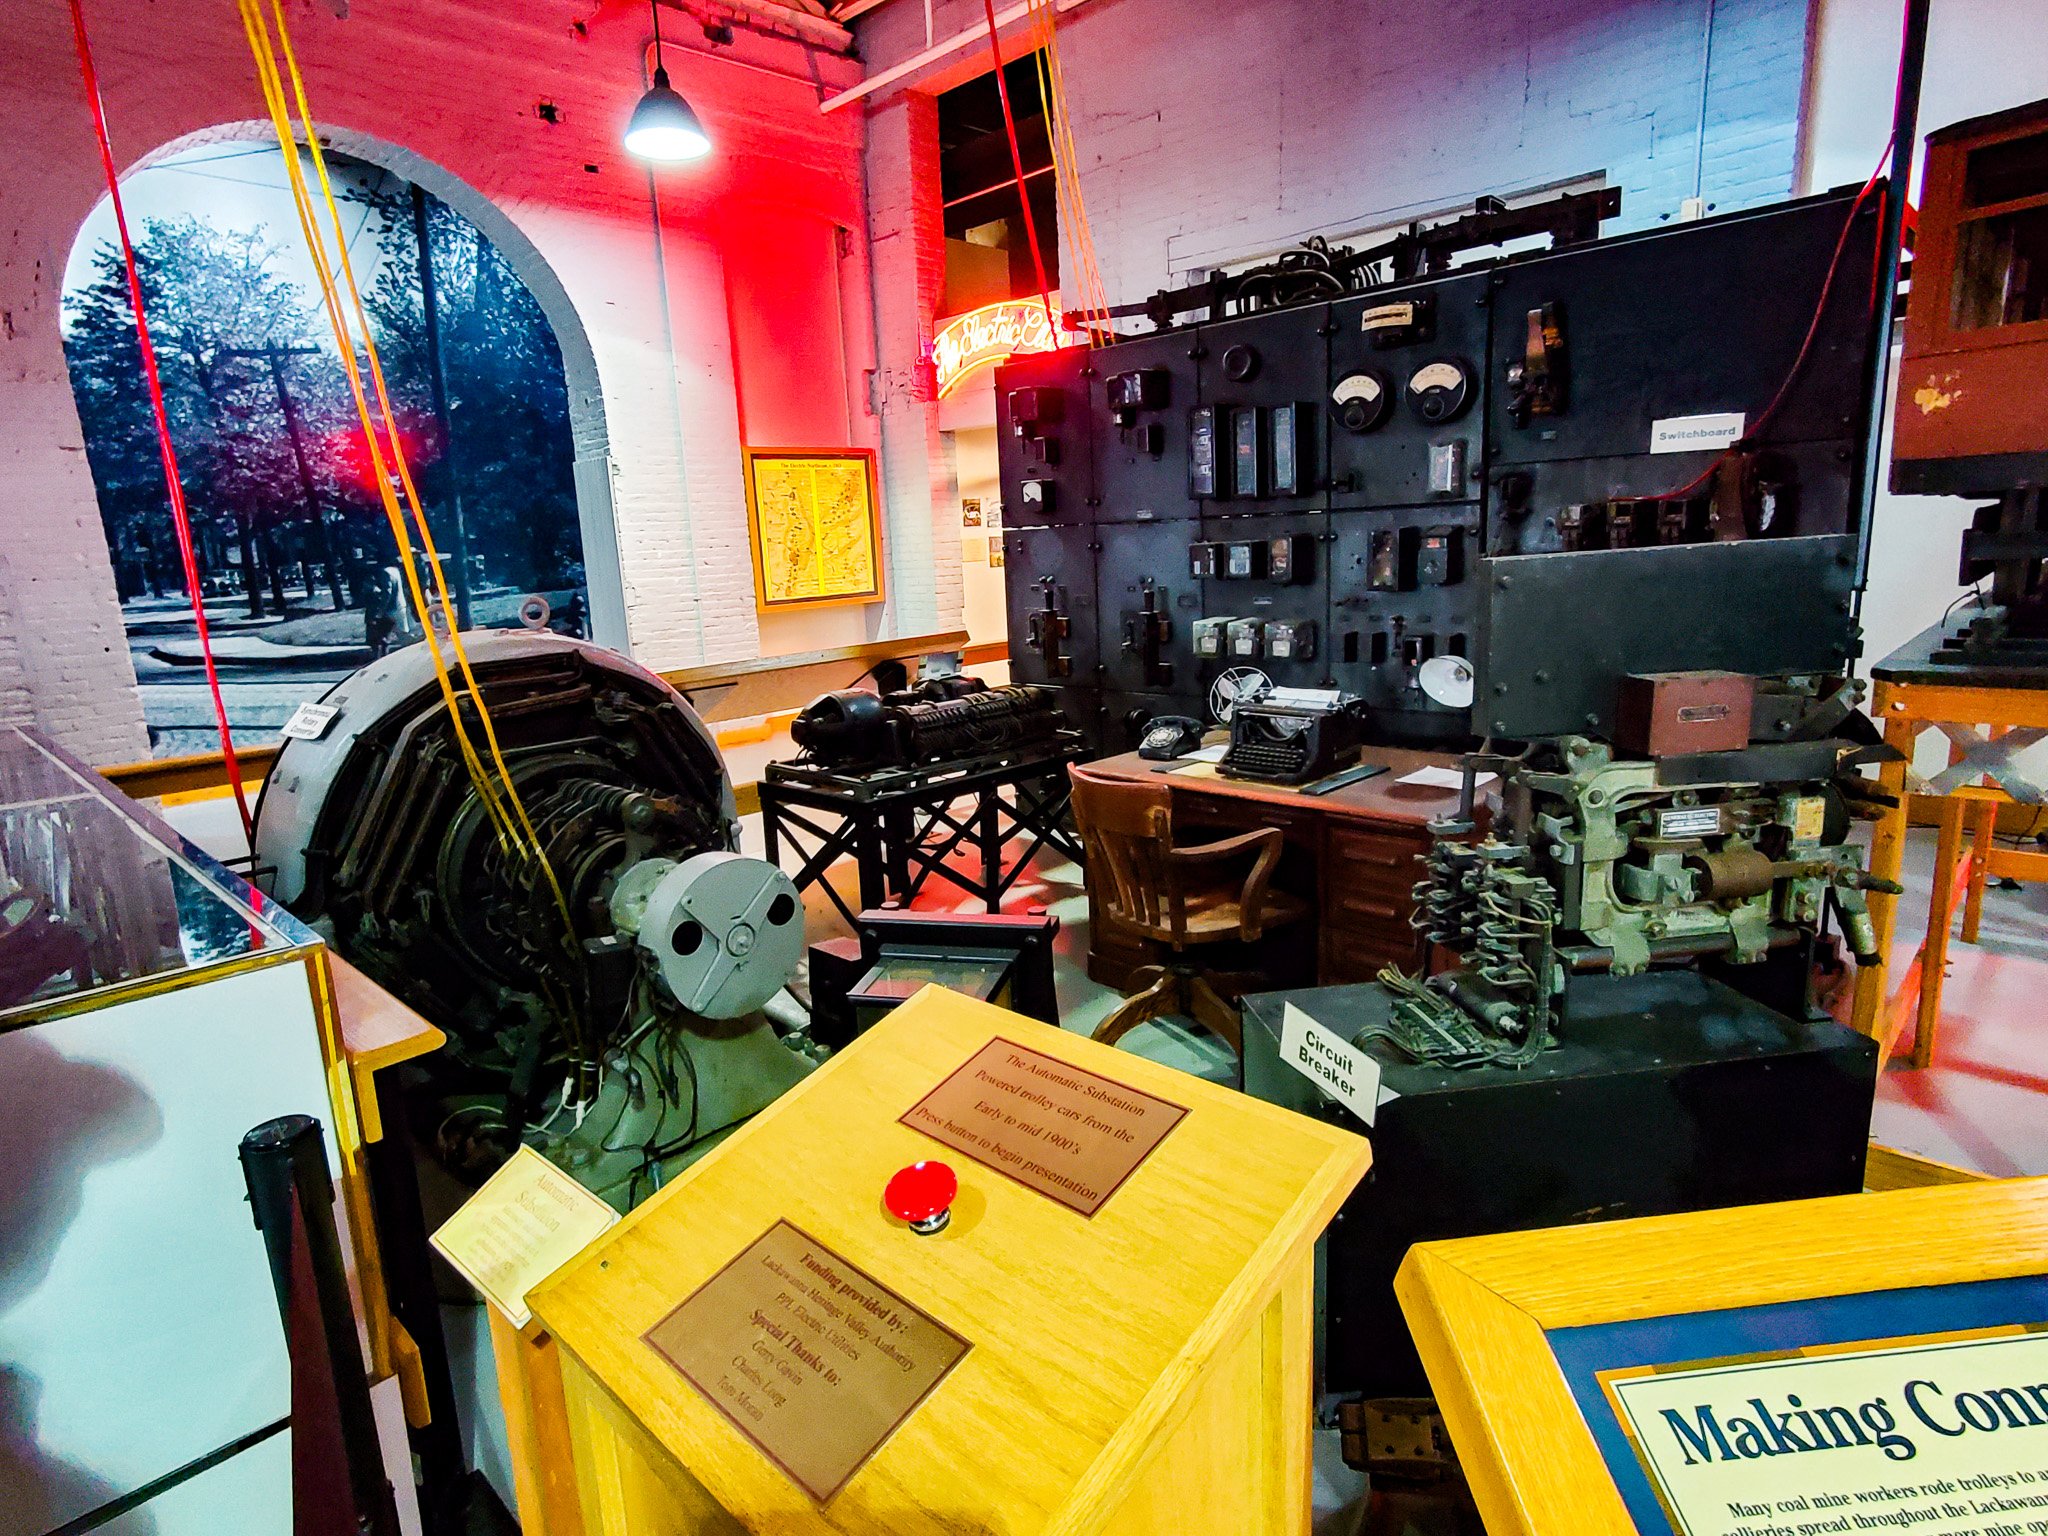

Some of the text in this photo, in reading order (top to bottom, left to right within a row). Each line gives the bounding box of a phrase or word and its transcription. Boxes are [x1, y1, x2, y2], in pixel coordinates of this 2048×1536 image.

[961, 306, 1021, 357] Electric
[1659, 427, 1736, 441] Switchboard
[1299, 1045, 1356, 1097] Breaker
[1305, 1030, 1353, 1075] Circuit
[975, 1069, 1134, 1143] Powered trolley cars from the
[1006, 1054, 1145, 1117] The Automatic Substation
[974, 1100, 1081, 1155] Early to mid 1900's
[915, 1107, 1098, 1201] Press button to begin presentation
[515, 1190, 561, 1232] Substation
[534, 1173, 580, 1212] Automatic
[761, 1255, 916, 1372] Lackawanna Heritage Valley Authority
[800, 1252, 909, 1334] Funding provided by:
[750, 1309, 841, 1387] Special Thanks to:
[775, 1292, 860, 1361] PPL Electric Utilities
[761, 1380, 787, 1408] Long
[1658, 1393, 1917, 1466] Making
[1726, 1502, 1773, 1519] Many
[1776, 1494, 1811, 1513] coal
[1811, 1491, 1852, 1508] mine
[1853, 1485, 1918, 1503] workers
[1919, 1478, 1957, 1496] rode
[1956, 1473, 2018, 1490] trolleys
[2016, 1470, 2035, 1484] to
[1796, 1514, 1852, 1536] spread
[1852, 1506, 1943, 1529] throughout
[1941, 1502, 1970, 1518] the
[2027, 1519, 2048, 1536] op
